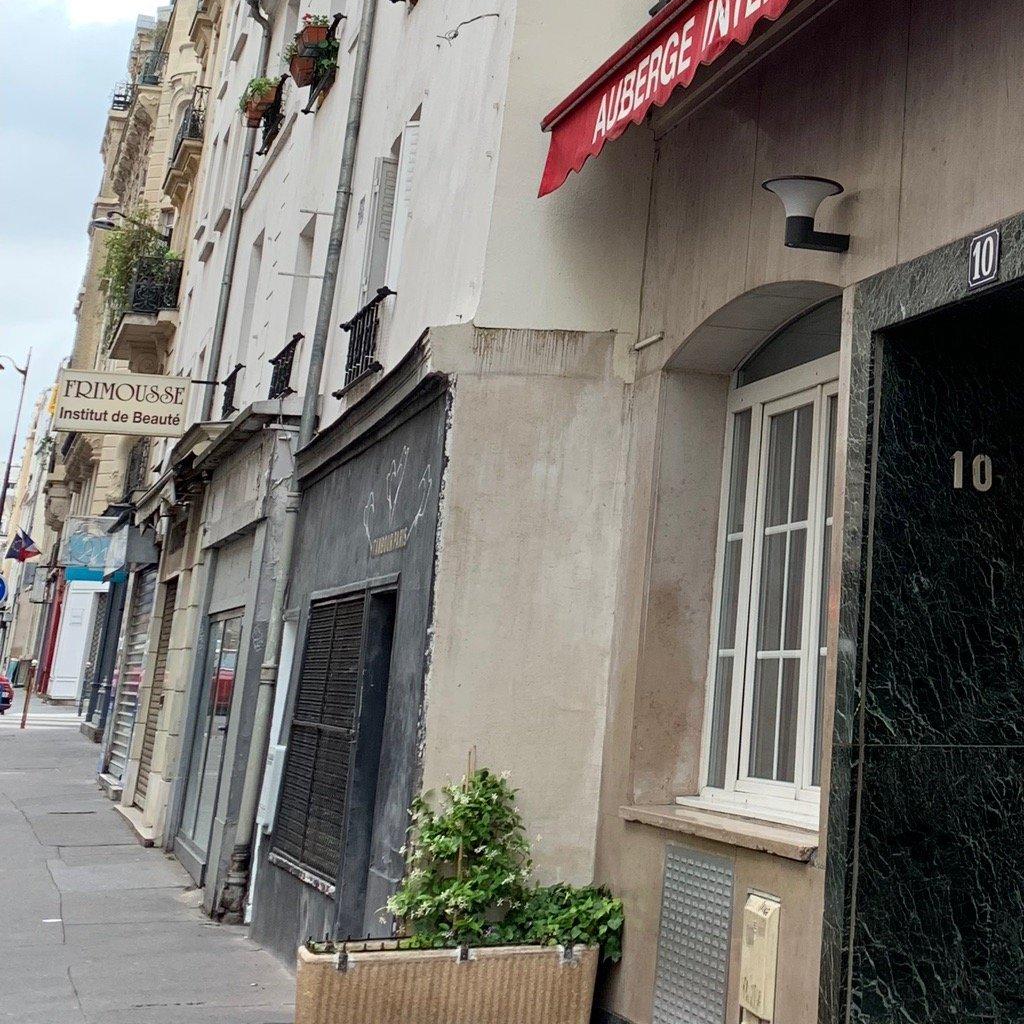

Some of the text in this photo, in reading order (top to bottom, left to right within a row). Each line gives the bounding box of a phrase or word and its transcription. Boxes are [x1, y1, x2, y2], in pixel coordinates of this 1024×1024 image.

[591, 16, 697, 144] AUBERGE
[972, 235, 995, 281] 10
[64, 379, 185, 405] FRIMOUSSE
[59, 406, 181, 426] Institut de Beauté
[950, 450, 993, 493] 10
